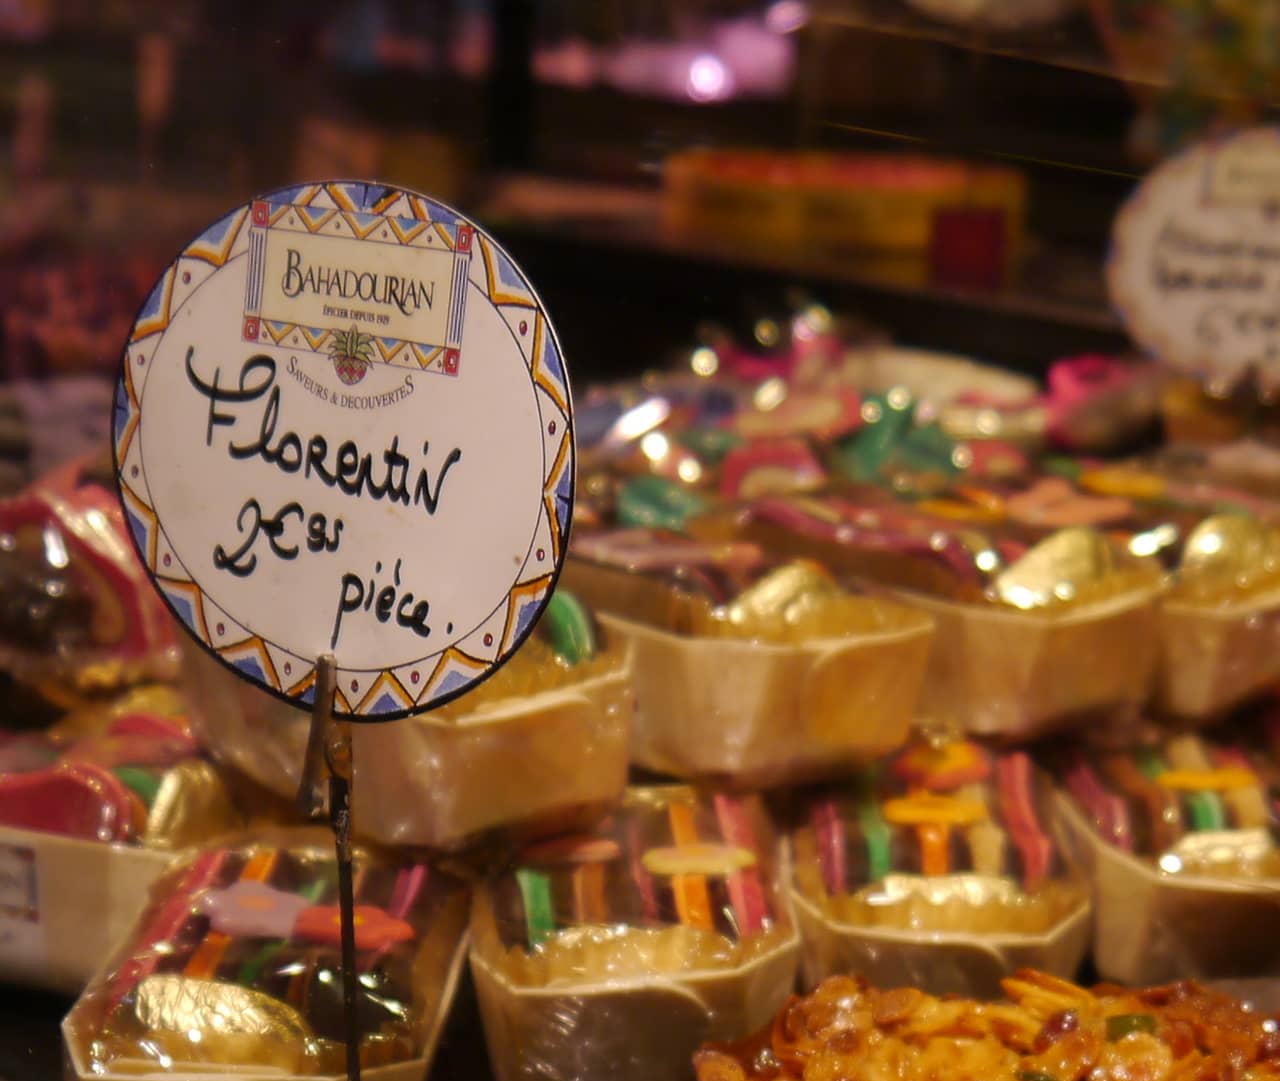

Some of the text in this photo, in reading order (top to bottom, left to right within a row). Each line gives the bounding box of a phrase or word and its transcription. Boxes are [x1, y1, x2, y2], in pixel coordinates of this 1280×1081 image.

[281, 248, 435, 316] BAHADOURIAN
[285, 355, 329, 401] SAVEURS
[329, 391, 339, 406] &
